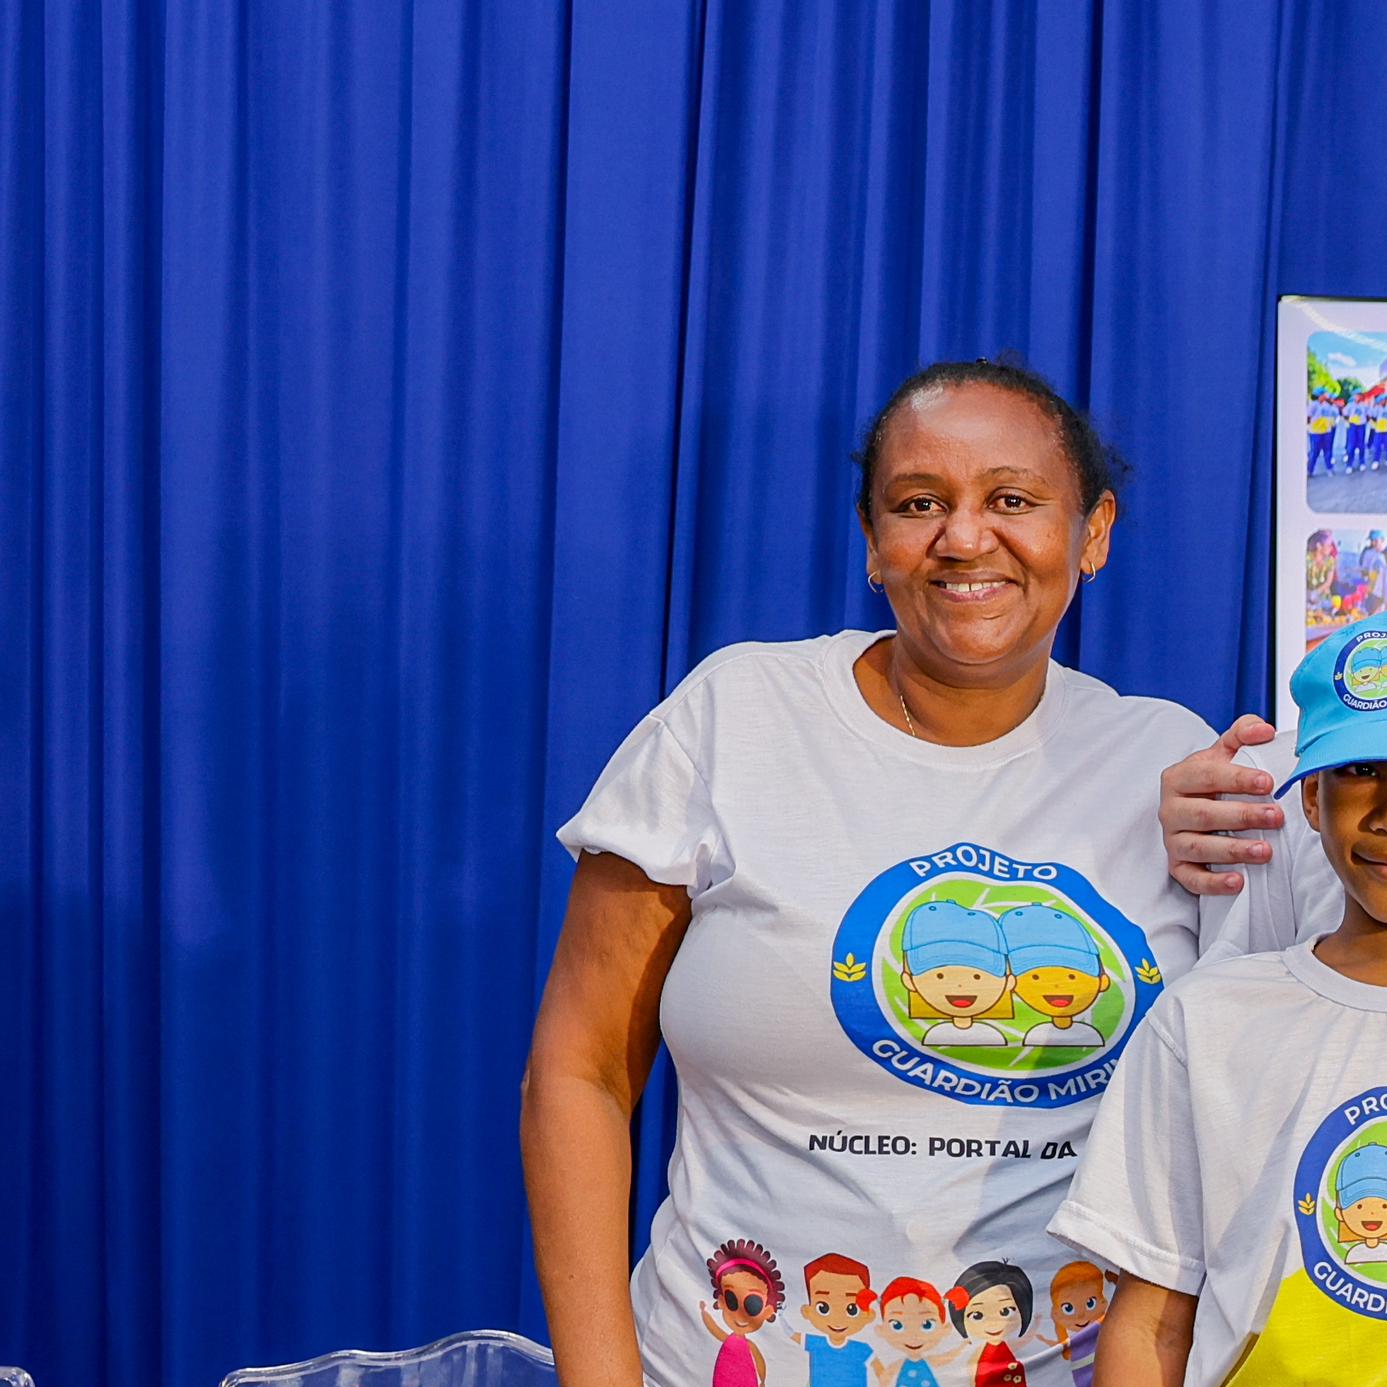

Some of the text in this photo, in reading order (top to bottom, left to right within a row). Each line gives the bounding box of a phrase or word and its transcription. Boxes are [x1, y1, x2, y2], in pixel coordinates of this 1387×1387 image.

[908, 844, 1058, 880] PROJETO
[872, 1039, 1040, 1104] GUARDIÃO
[808, 1130, 1078, 1160] NÚCLEO: PORTAL DA
